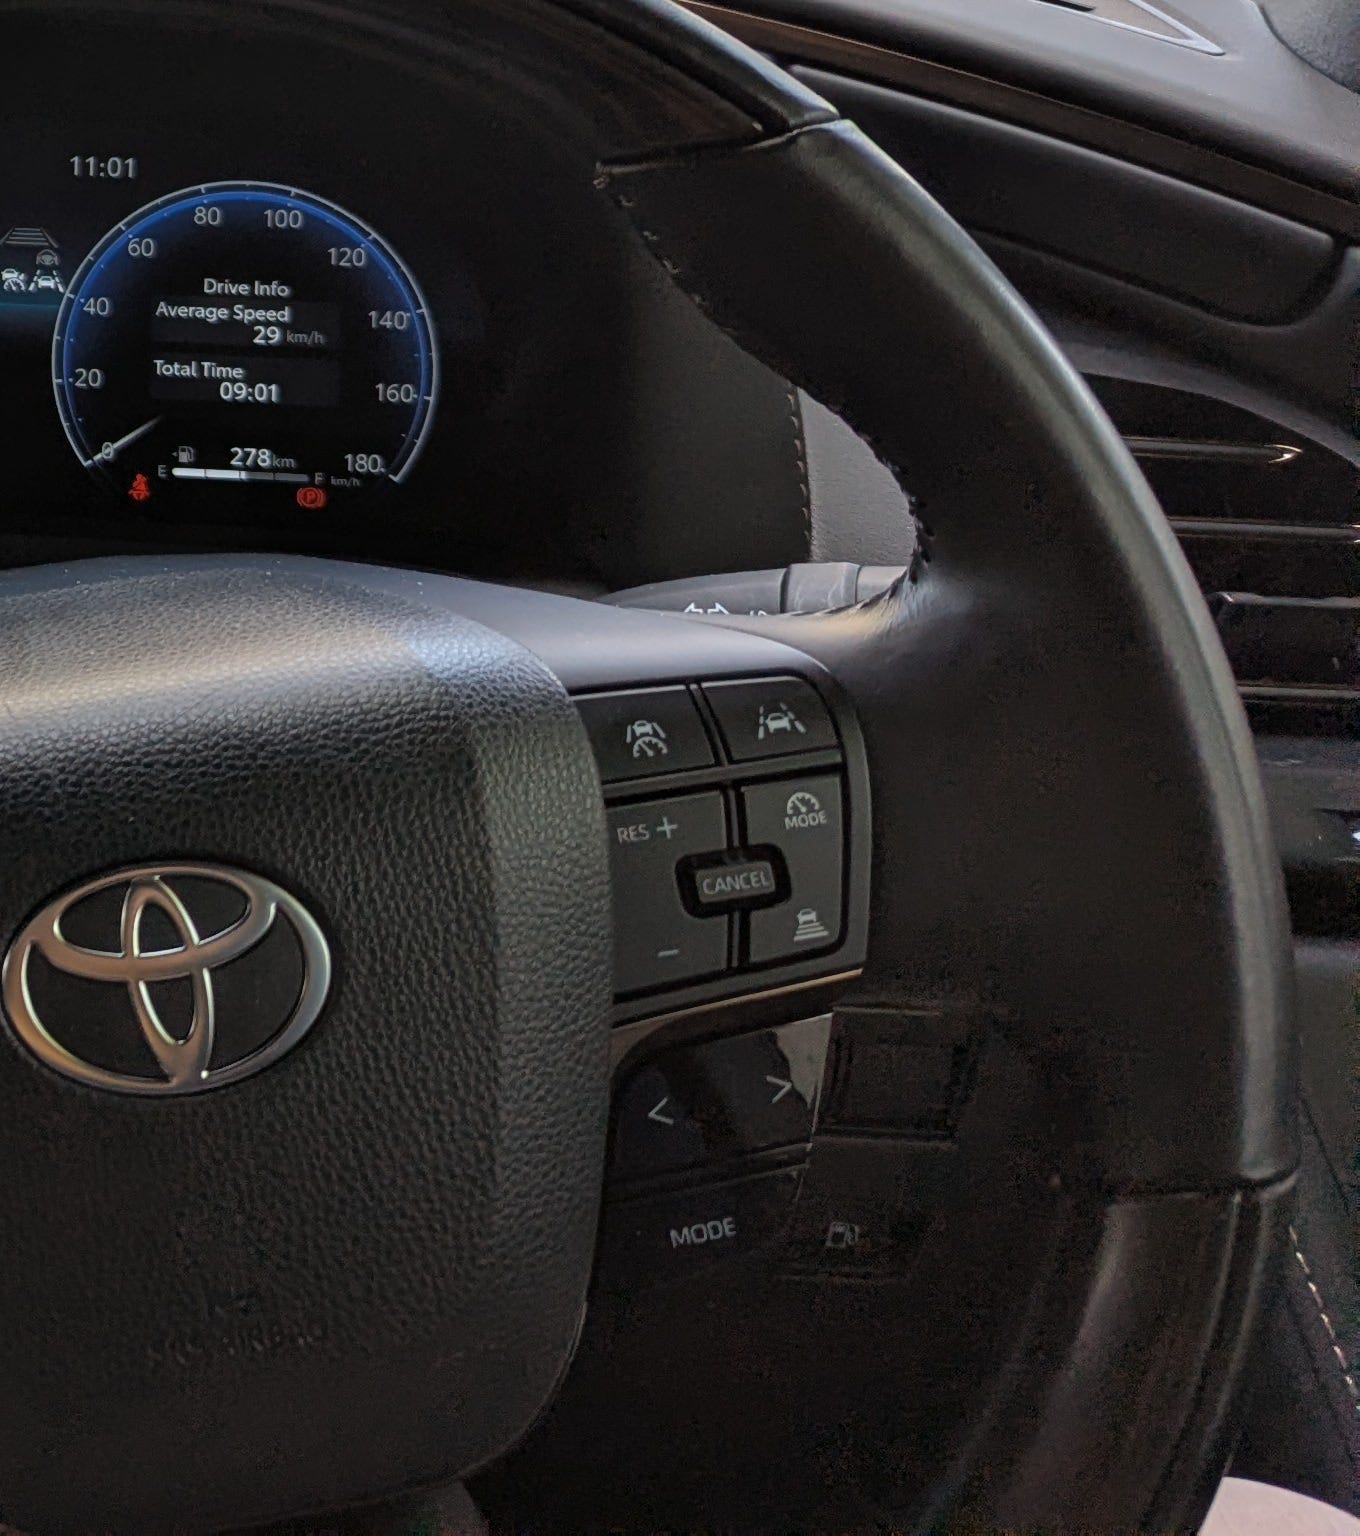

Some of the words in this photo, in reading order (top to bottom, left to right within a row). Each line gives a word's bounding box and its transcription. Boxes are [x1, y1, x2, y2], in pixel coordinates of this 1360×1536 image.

[69, 155, 137, 178] 11:01
[193, 206, 222, 227] 80
[263, 208, 304, 229] 100
[127, 237, 156, 258] 60
[328, 246, 366, 267] 120
[204, 278, 249, 295] Drive
[255, 280, 291, 297] Info
[83, 297, 111, 316] 40
[155, 301, 229, 323] Average
[233, 304, 291, 324] Speed
[367, 310, 406, 331] 140
[253, 325, 280, 345] 29
[286, 329, 325, 345] km/h
[74, 369, 102, 388] 20
[153, 359, 197, 377] Total
[201, 361, 245, 379] Time
[220, 382, 281, 402] 09:01
[375, 383, 414, 403] 160
[344, 454, 380, 473] 180
[784, 810, 827, 830] MODE
[617, 823, 650, 844] RES
[702, 870, 771, 895] CANCEL
[670, 1217, 736, 1248] MODE
